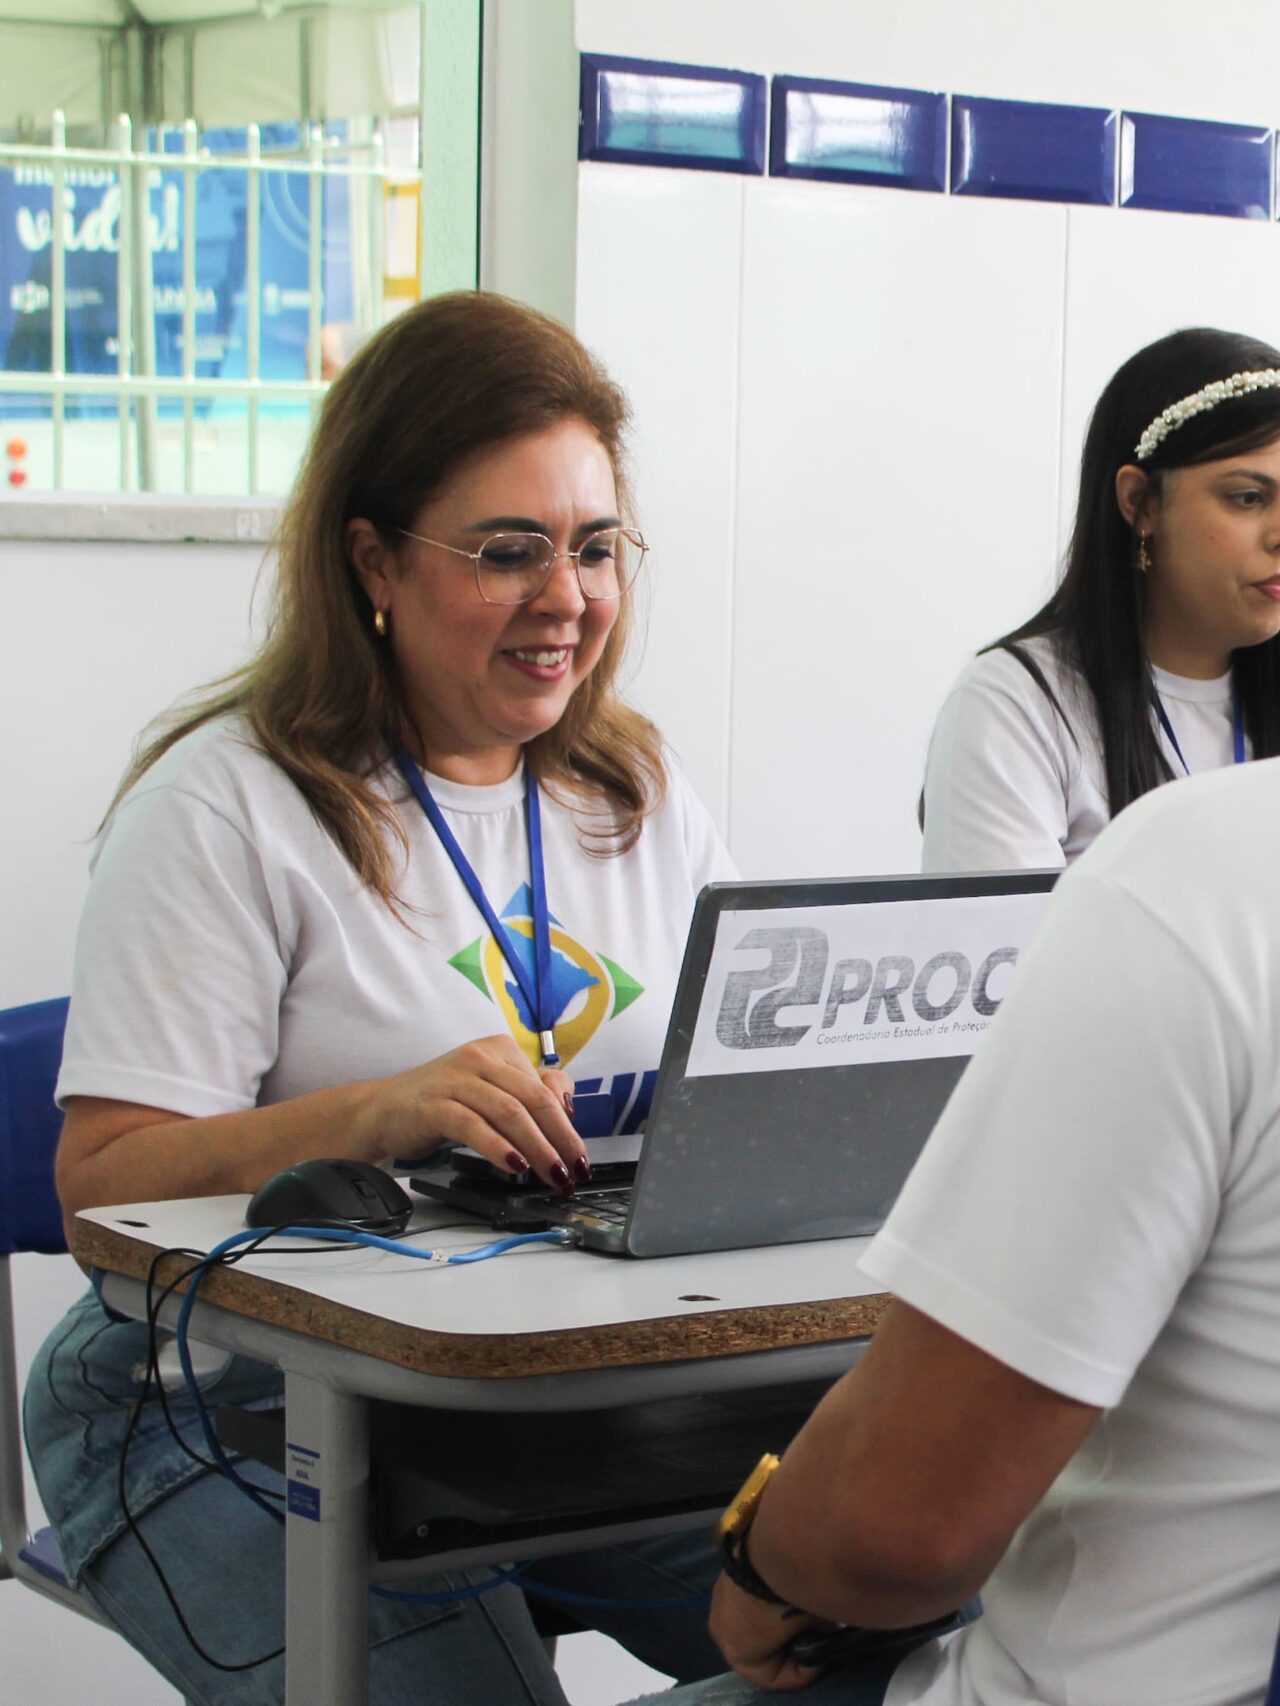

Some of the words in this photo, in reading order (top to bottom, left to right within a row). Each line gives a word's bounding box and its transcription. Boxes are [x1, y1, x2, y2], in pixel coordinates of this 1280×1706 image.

[816, 1030, 891, 1045] Coordenadoria
[893, 1025, 935, 1038] Estadual
[938, 1023, 950, 1034] de
